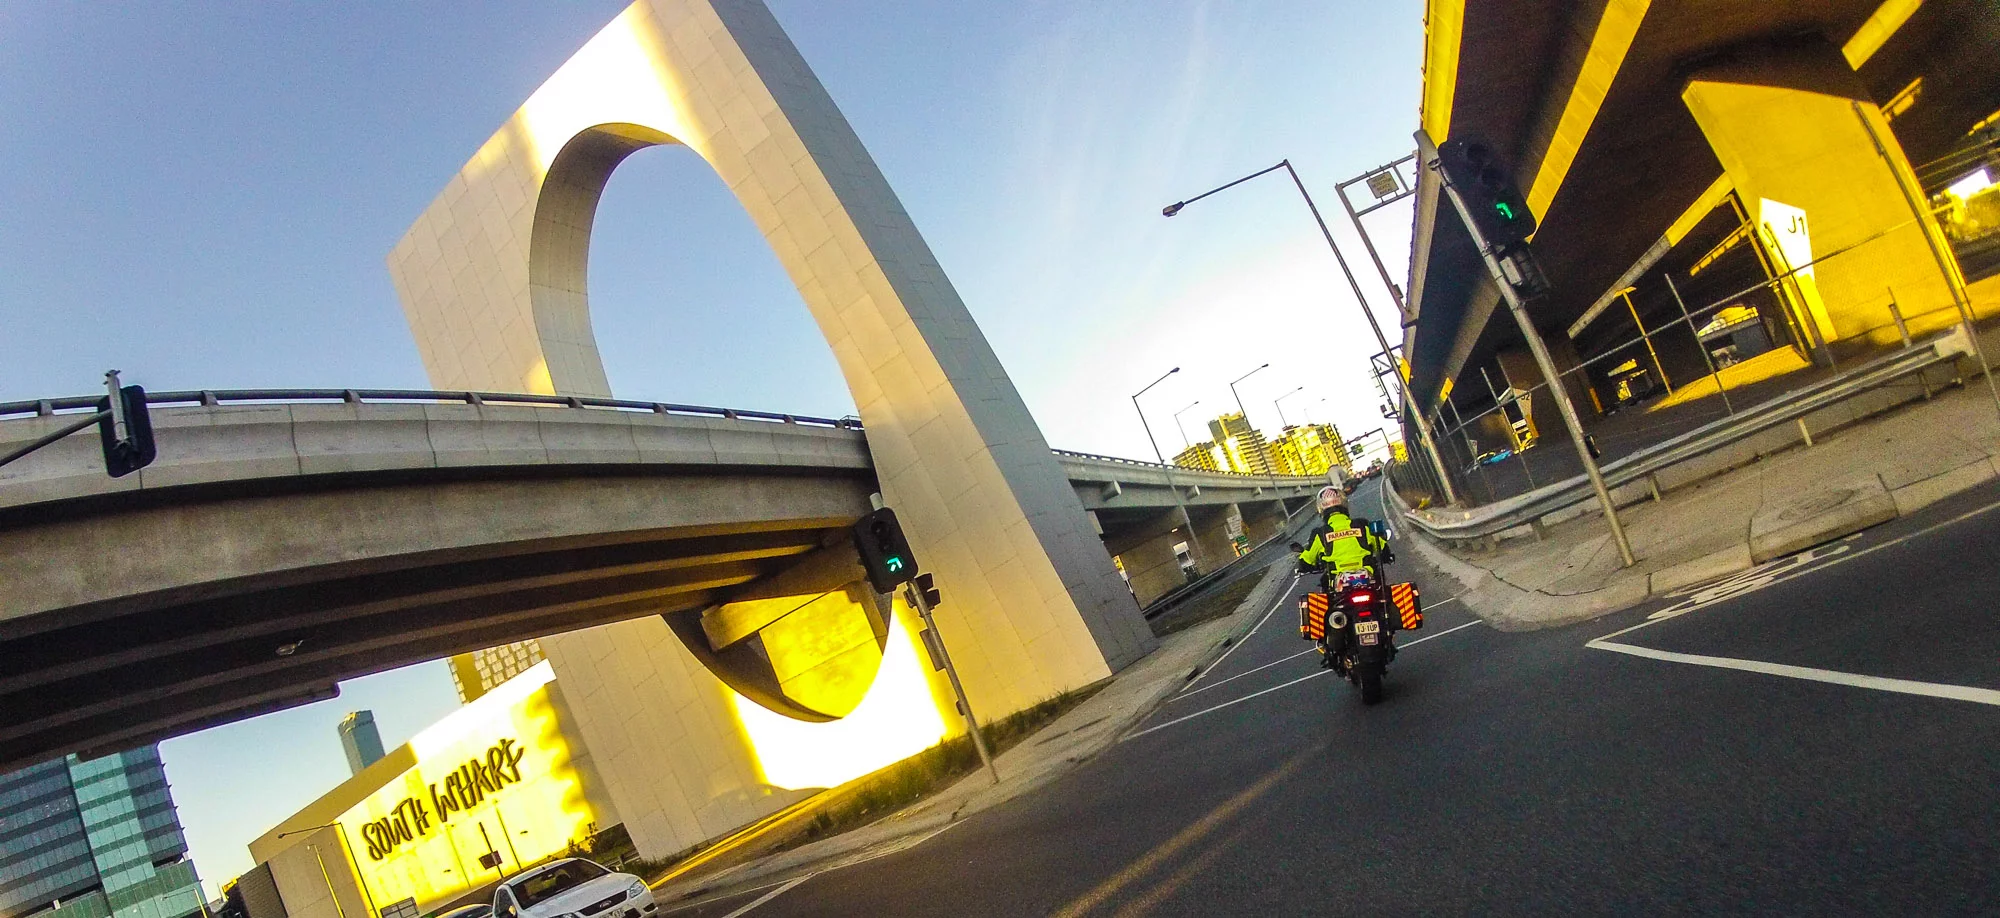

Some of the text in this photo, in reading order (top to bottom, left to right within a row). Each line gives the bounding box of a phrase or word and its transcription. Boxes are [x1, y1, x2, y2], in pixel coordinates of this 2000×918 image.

[1787, 214, 1806, 236] J1
[1327, 529, 1360, 541] PARAMEDIC
[361, 738, 525, 861] SOUTH WHARF
